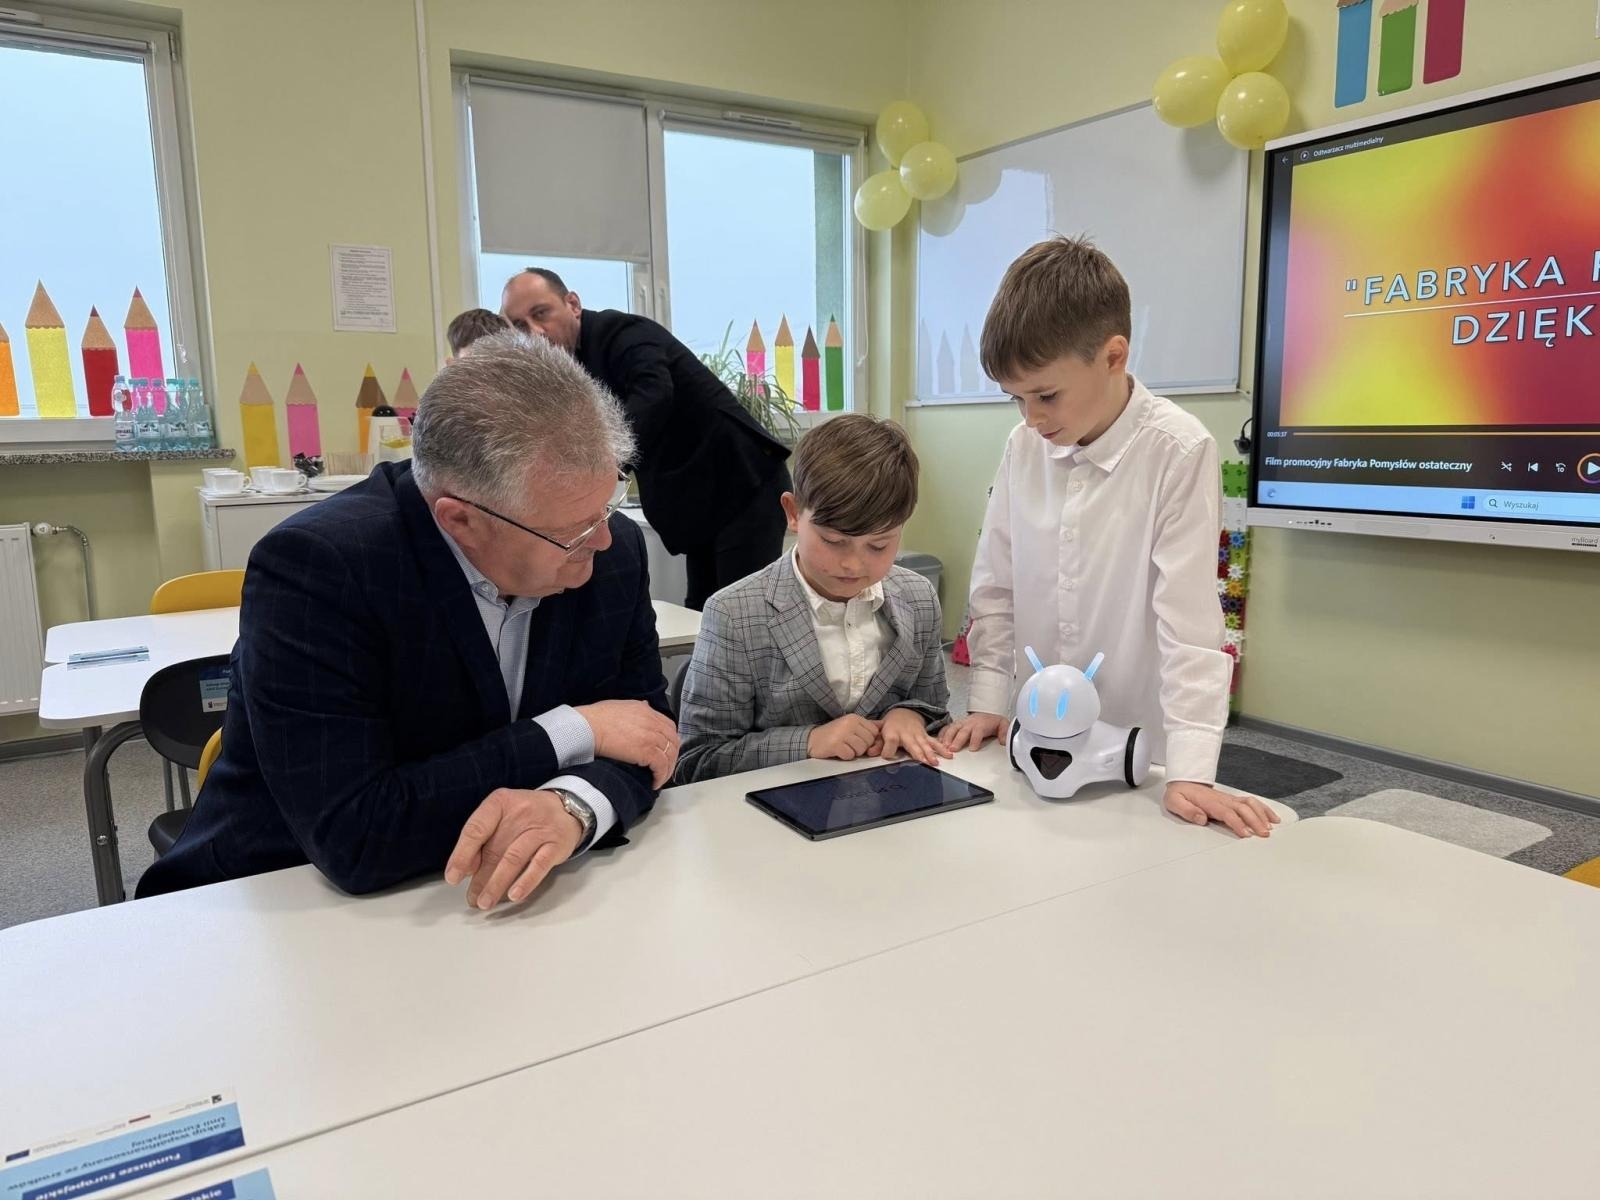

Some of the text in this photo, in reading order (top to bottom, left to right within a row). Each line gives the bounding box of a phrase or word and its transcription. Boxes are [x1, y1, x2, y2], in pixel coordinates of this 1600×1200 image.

[1345, 255, 1565, 306] "FABRYKA
[1265, 456, 1473, 473] Film promocyjny Fabryka Pomysłów ostateczny
[1503, 500, 1539, 511] Wyszukaj
